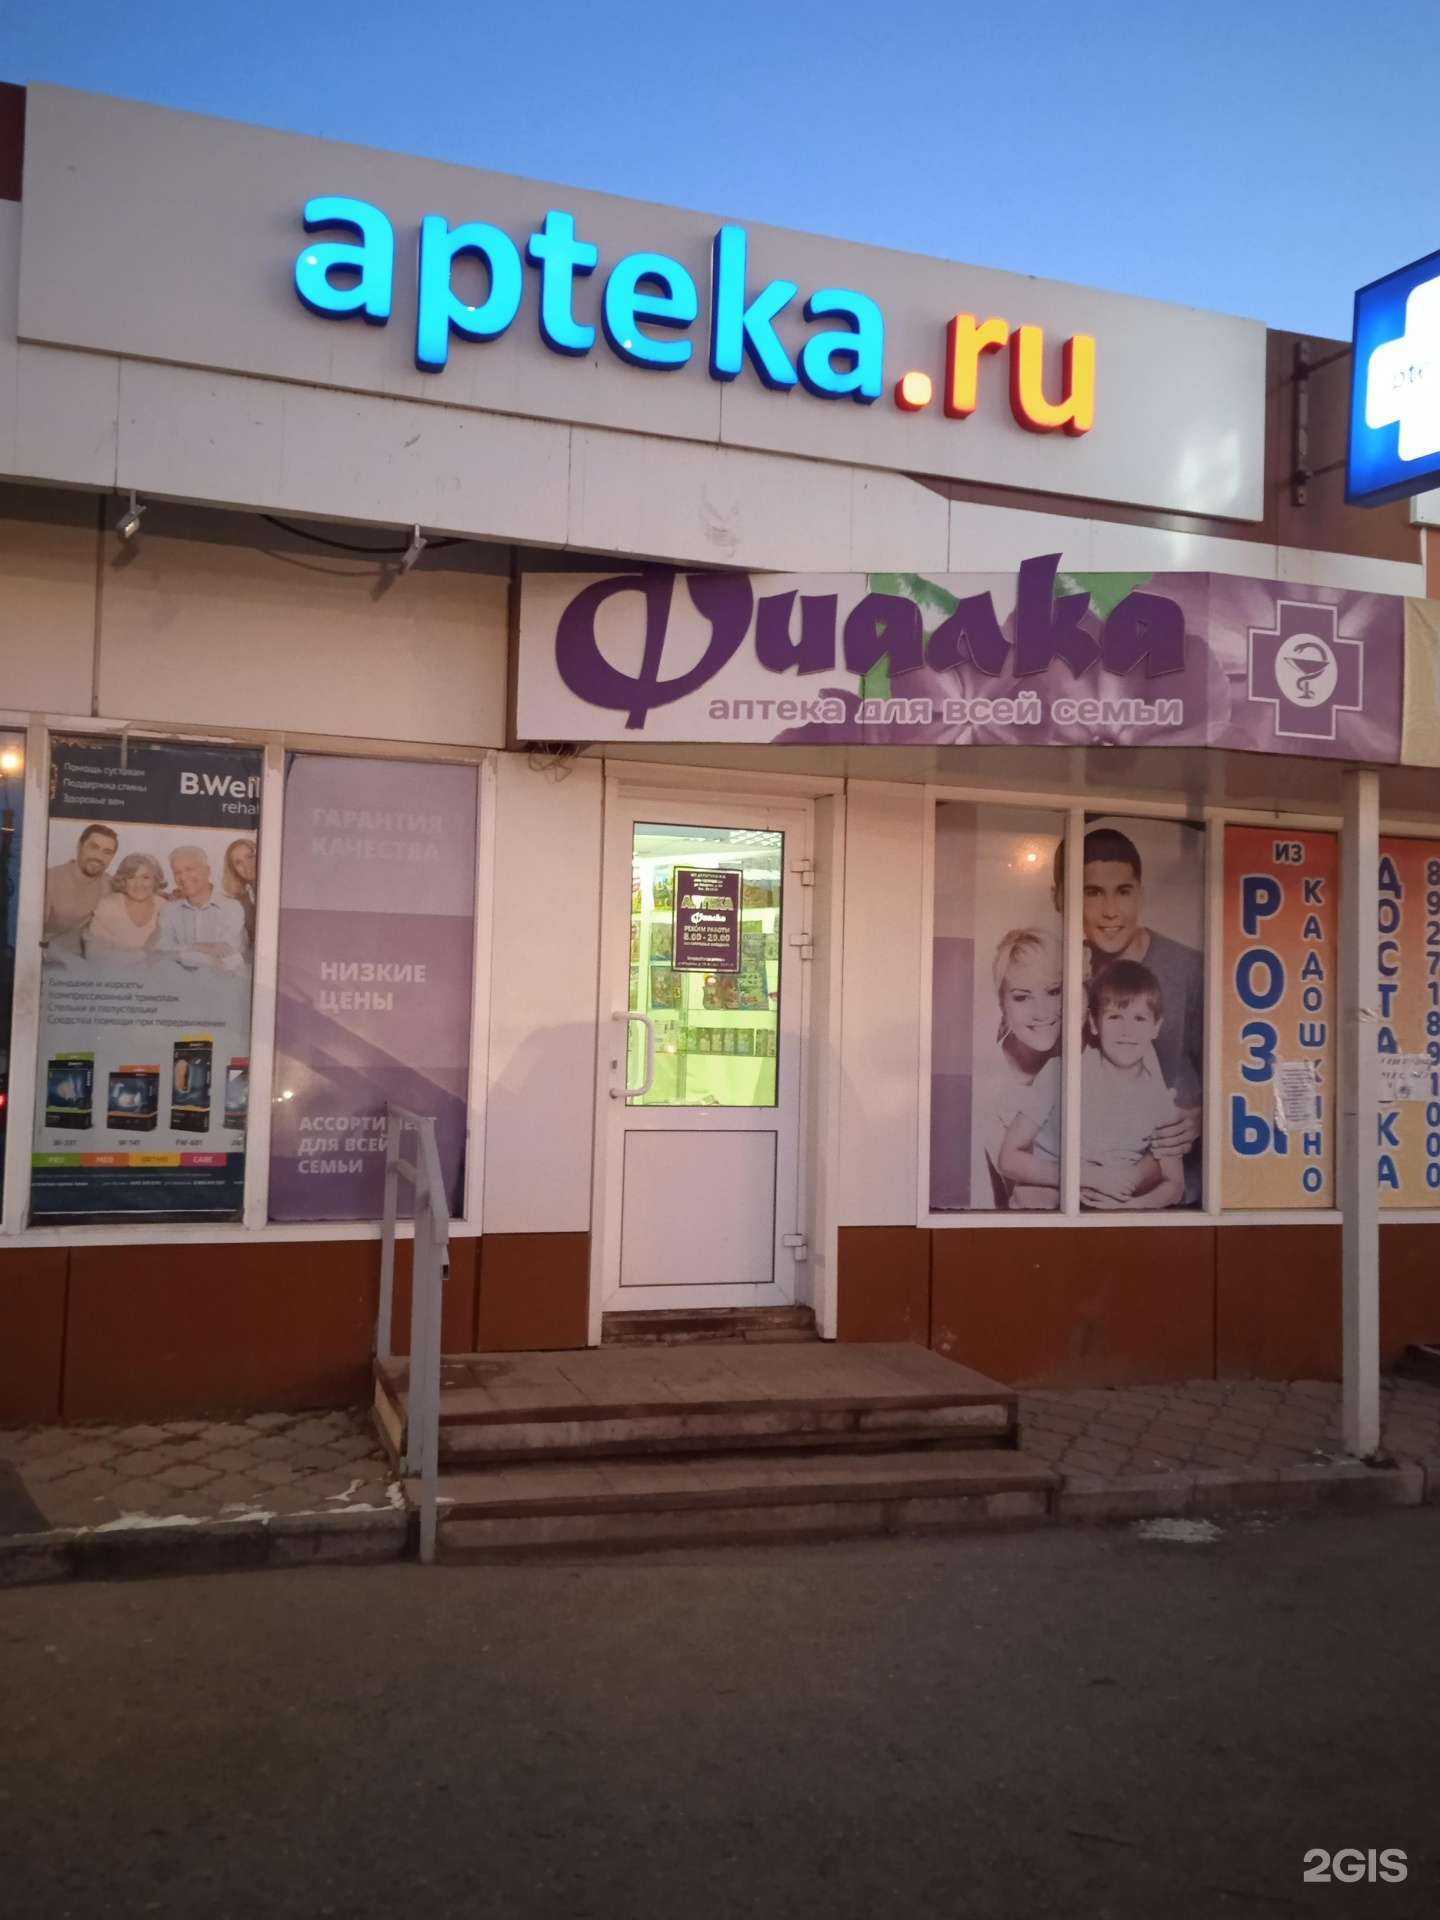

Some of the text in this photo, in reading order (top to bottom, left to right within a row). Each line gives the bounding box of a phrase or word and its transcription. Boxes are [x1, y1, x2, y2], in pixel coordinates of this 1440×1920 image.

[294, 195, 1095, 438] apteka.ru
[555, 553, 1185, 729] Фиалка
[708, 692, 1182, 725] аптека для всей семьи
[313, 809, 442, 833] ГАРАНТИЯ
[312, 837, 440, 861] КАЧЕСТВА
[1274, 842, 1304, 864] ИЗ
[320, 961, 426, 983] НИЗКИЕ
[319, 990, 393, 1012] ЦЕНЫ
[1232, 876, 1288, 1155] РОЗЫ
[1378, 856, 1402, 1190] ДОСТАКА
[298, 1133, 389, 1156] ДЛЯ ВСЕЙ
[298, 1159, 363, 1174] СЕМЬИ
